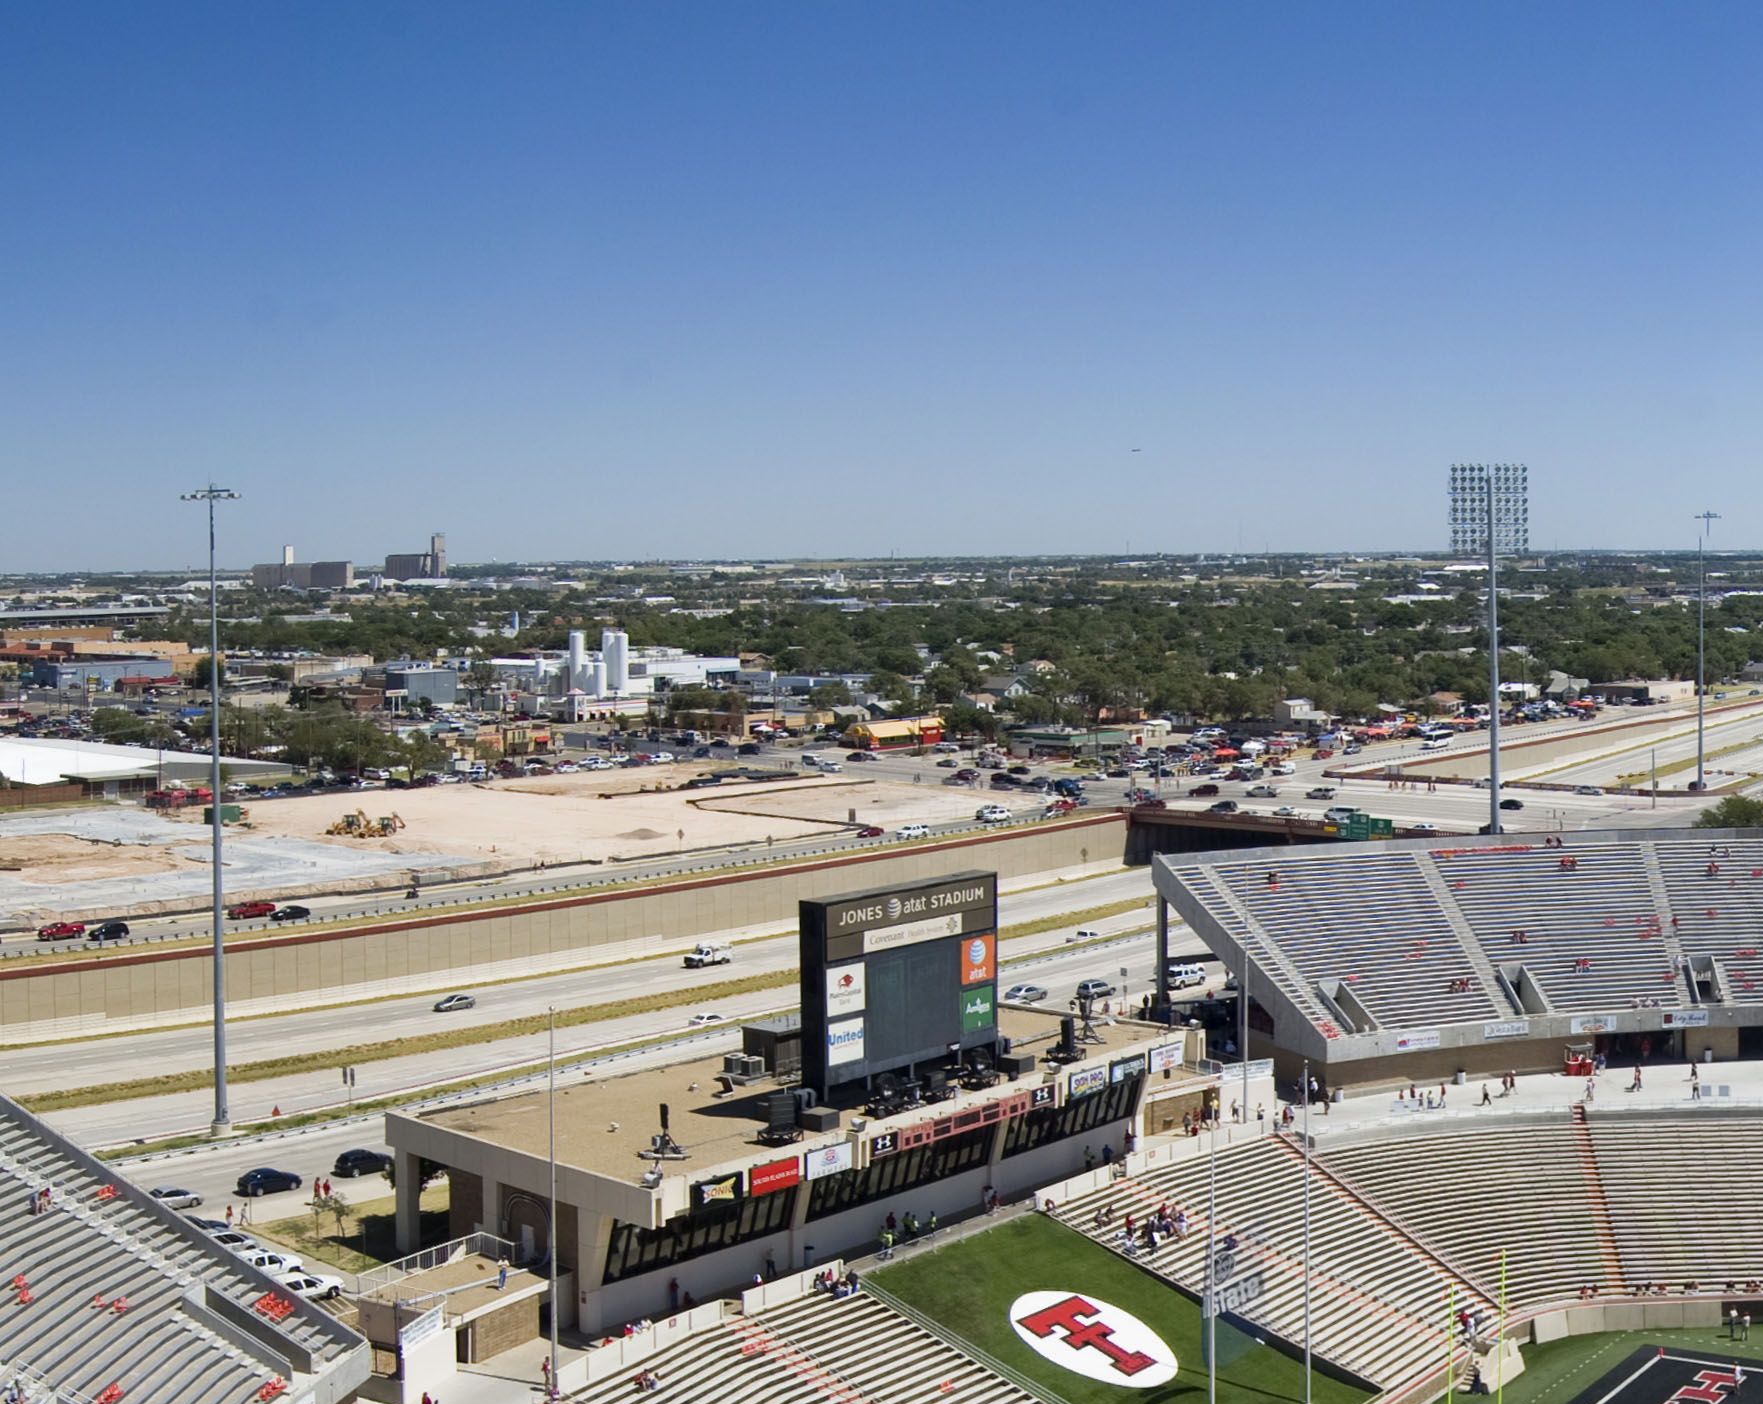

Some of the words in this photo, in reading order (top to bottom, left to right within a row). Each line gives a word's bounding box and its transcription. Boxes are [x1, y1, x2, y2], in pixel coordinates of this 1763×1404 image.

[839, 905, 883, 926] JONES
[903, 896, 927, 914] at&t
[931, 886, 985, 908] STADIUM
[869, 931, 905, 946] Covenant
[828, 1027, 864, 1047] United
[704, 1183, 734, 1200] SONIC
